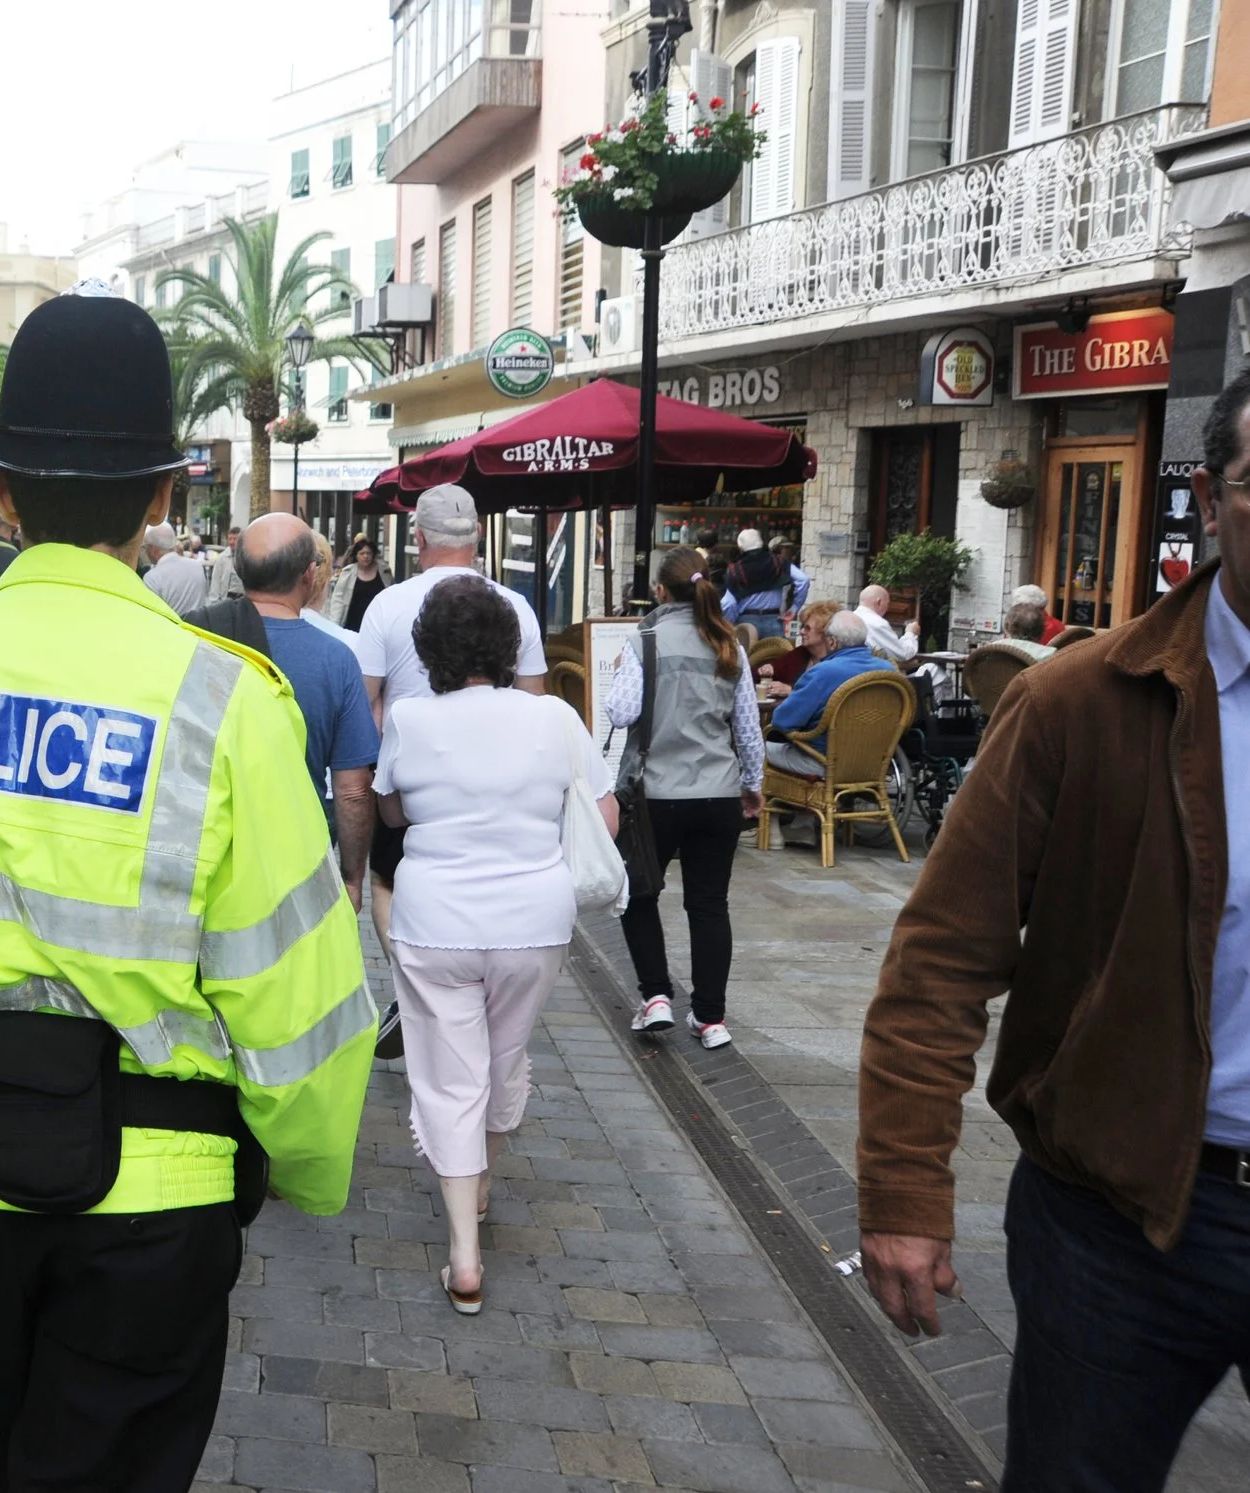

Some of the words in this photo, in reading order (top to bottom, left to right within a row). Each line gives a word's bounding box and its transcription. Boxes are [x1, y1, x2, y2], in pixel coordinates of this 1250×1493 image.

[495, 356, 548, 369] Heineken
[1029, 344, 1076, 376] THE
[1084, 336, 1171, 372] GIBRA
[708, 366, 780, 408] BROS
[502, 436, 614, 462] GIBRALTAR
